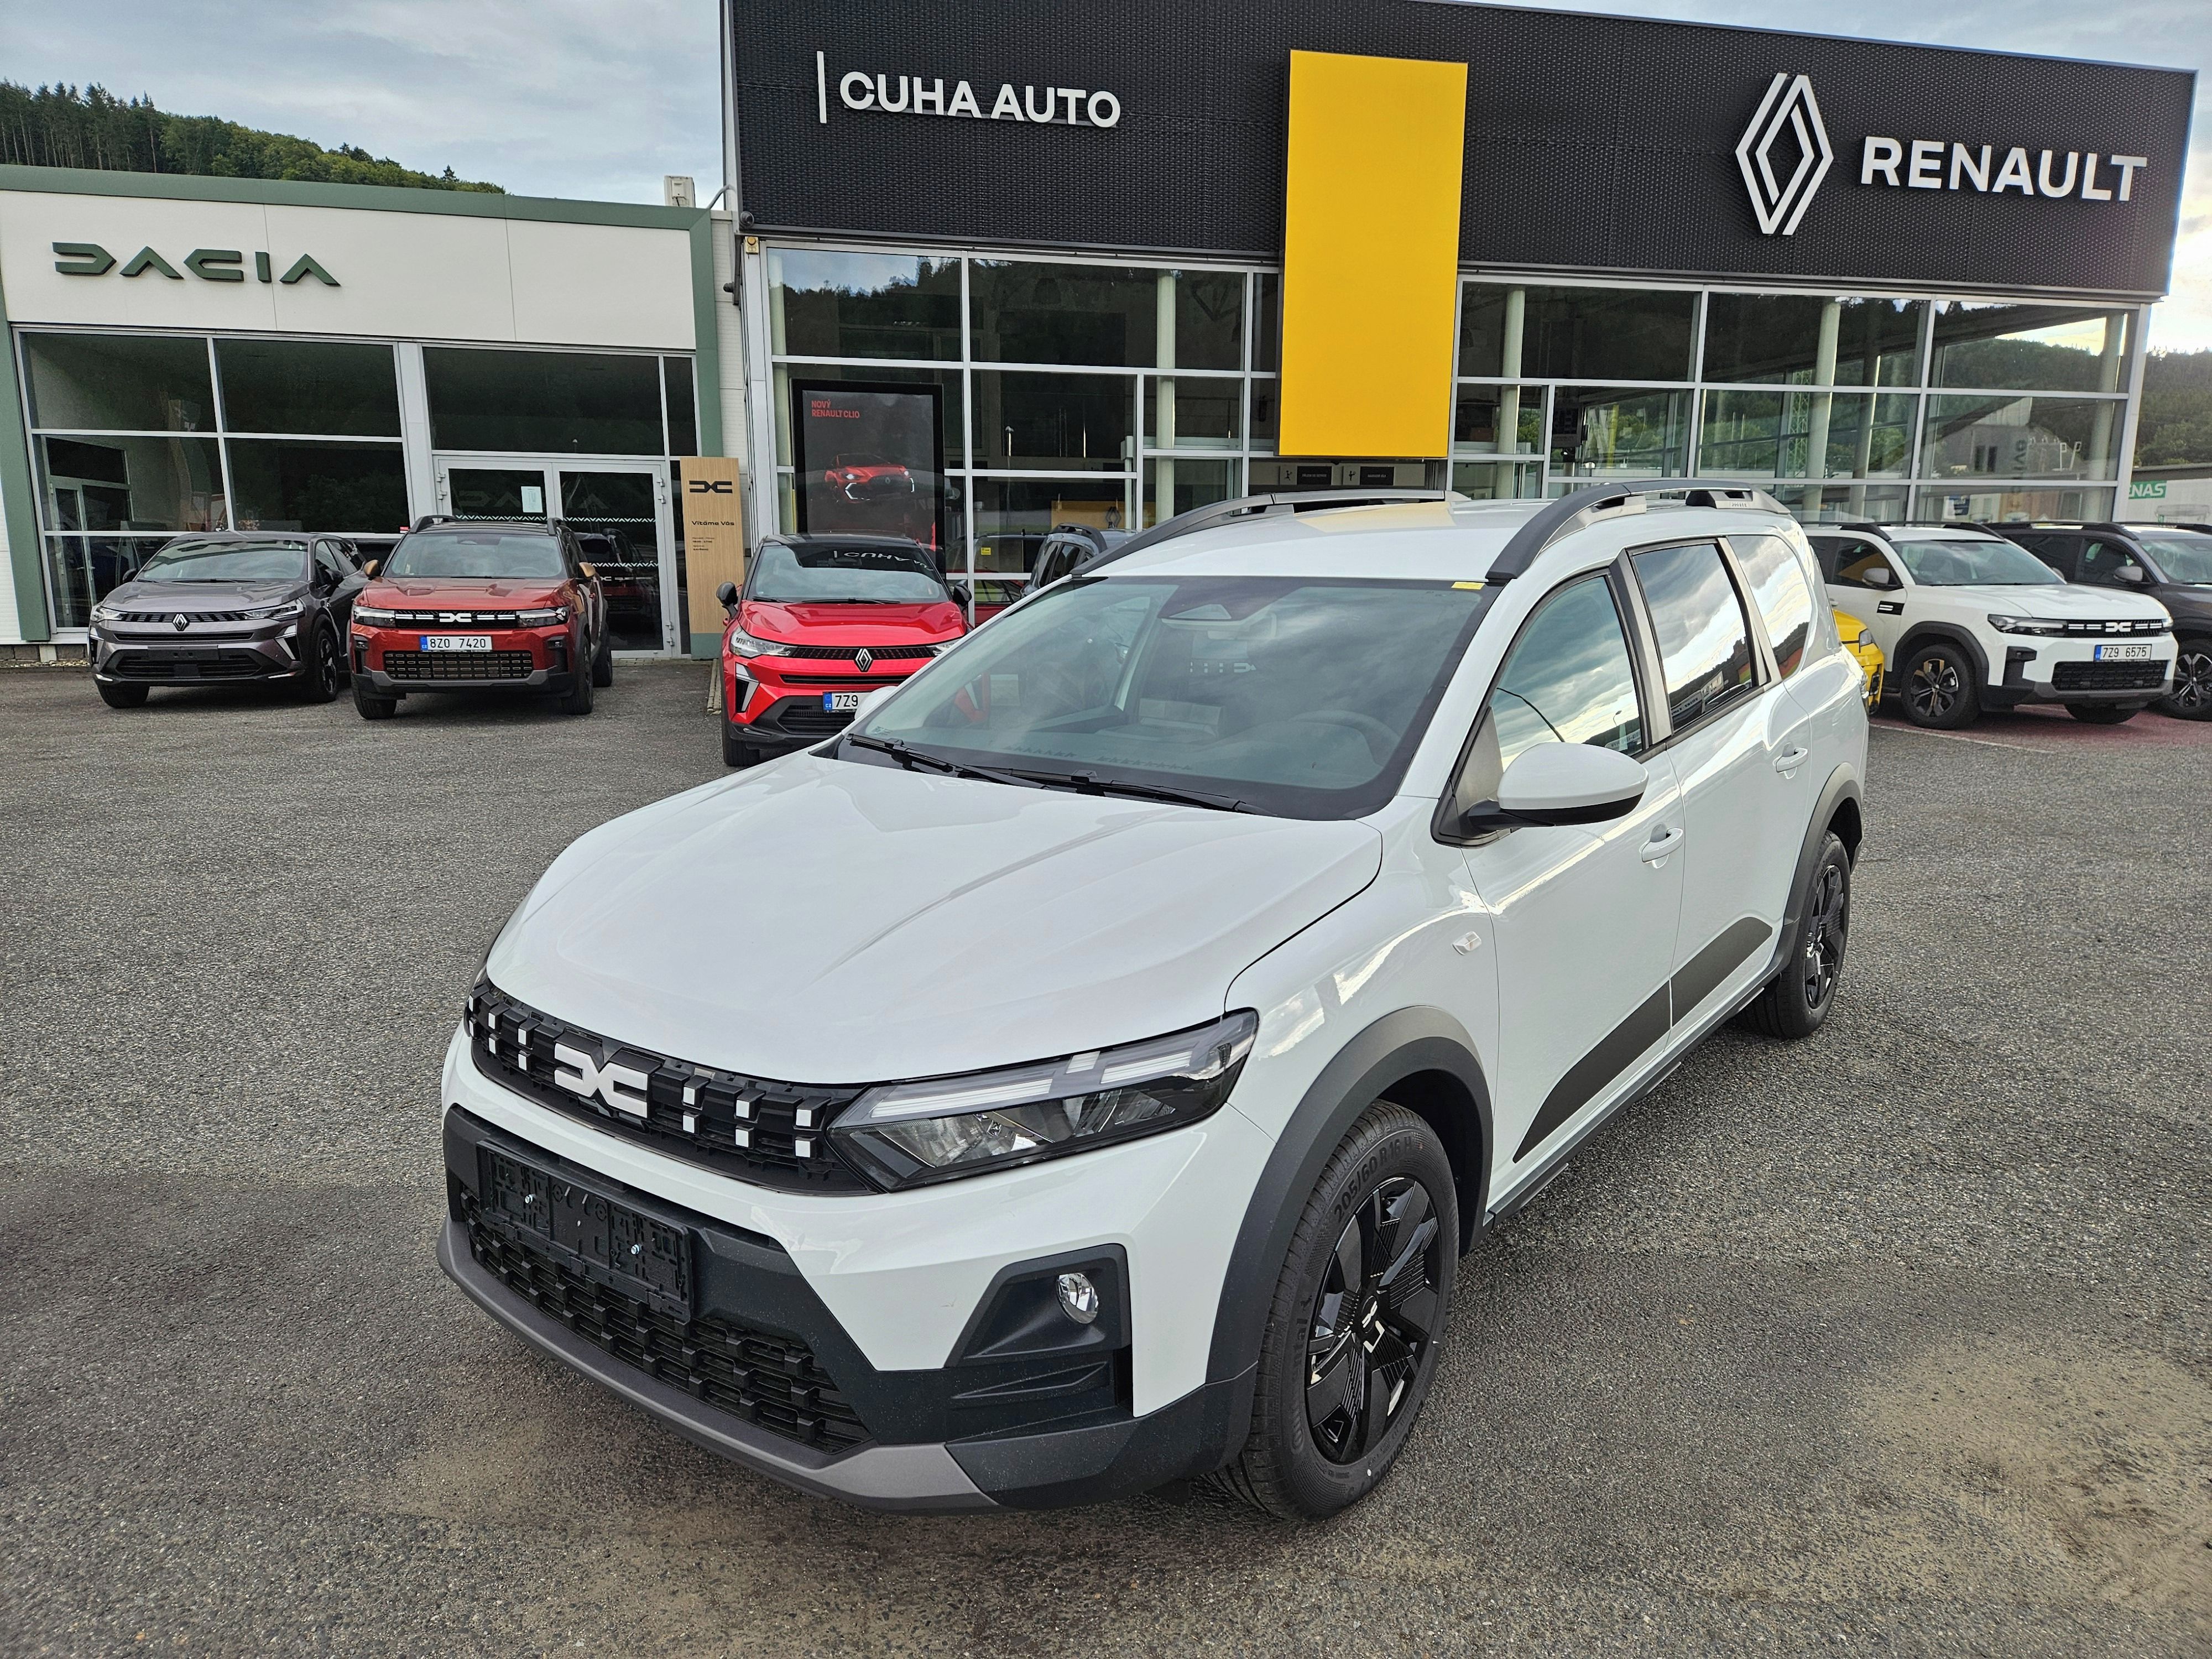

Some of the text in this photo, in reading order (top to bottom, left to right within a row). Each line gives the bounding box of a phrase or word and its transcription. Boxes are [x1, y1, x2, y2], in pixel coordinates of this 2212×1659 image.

[839, 71, 1121, 128] CUHA AUTO
[1861, 136, 2147, 201] RENAULT
[52, 242, 341, 286] DACIA
[811, 399, 831, 408] NOVÝ
[812, 409, 860, 419] RENAULT CLIO
[458, 638, 486, 648] 7420
[2103, 646, 2147, 658] 7Z9 6575
[835, 695, 858, 707] 7Z9
